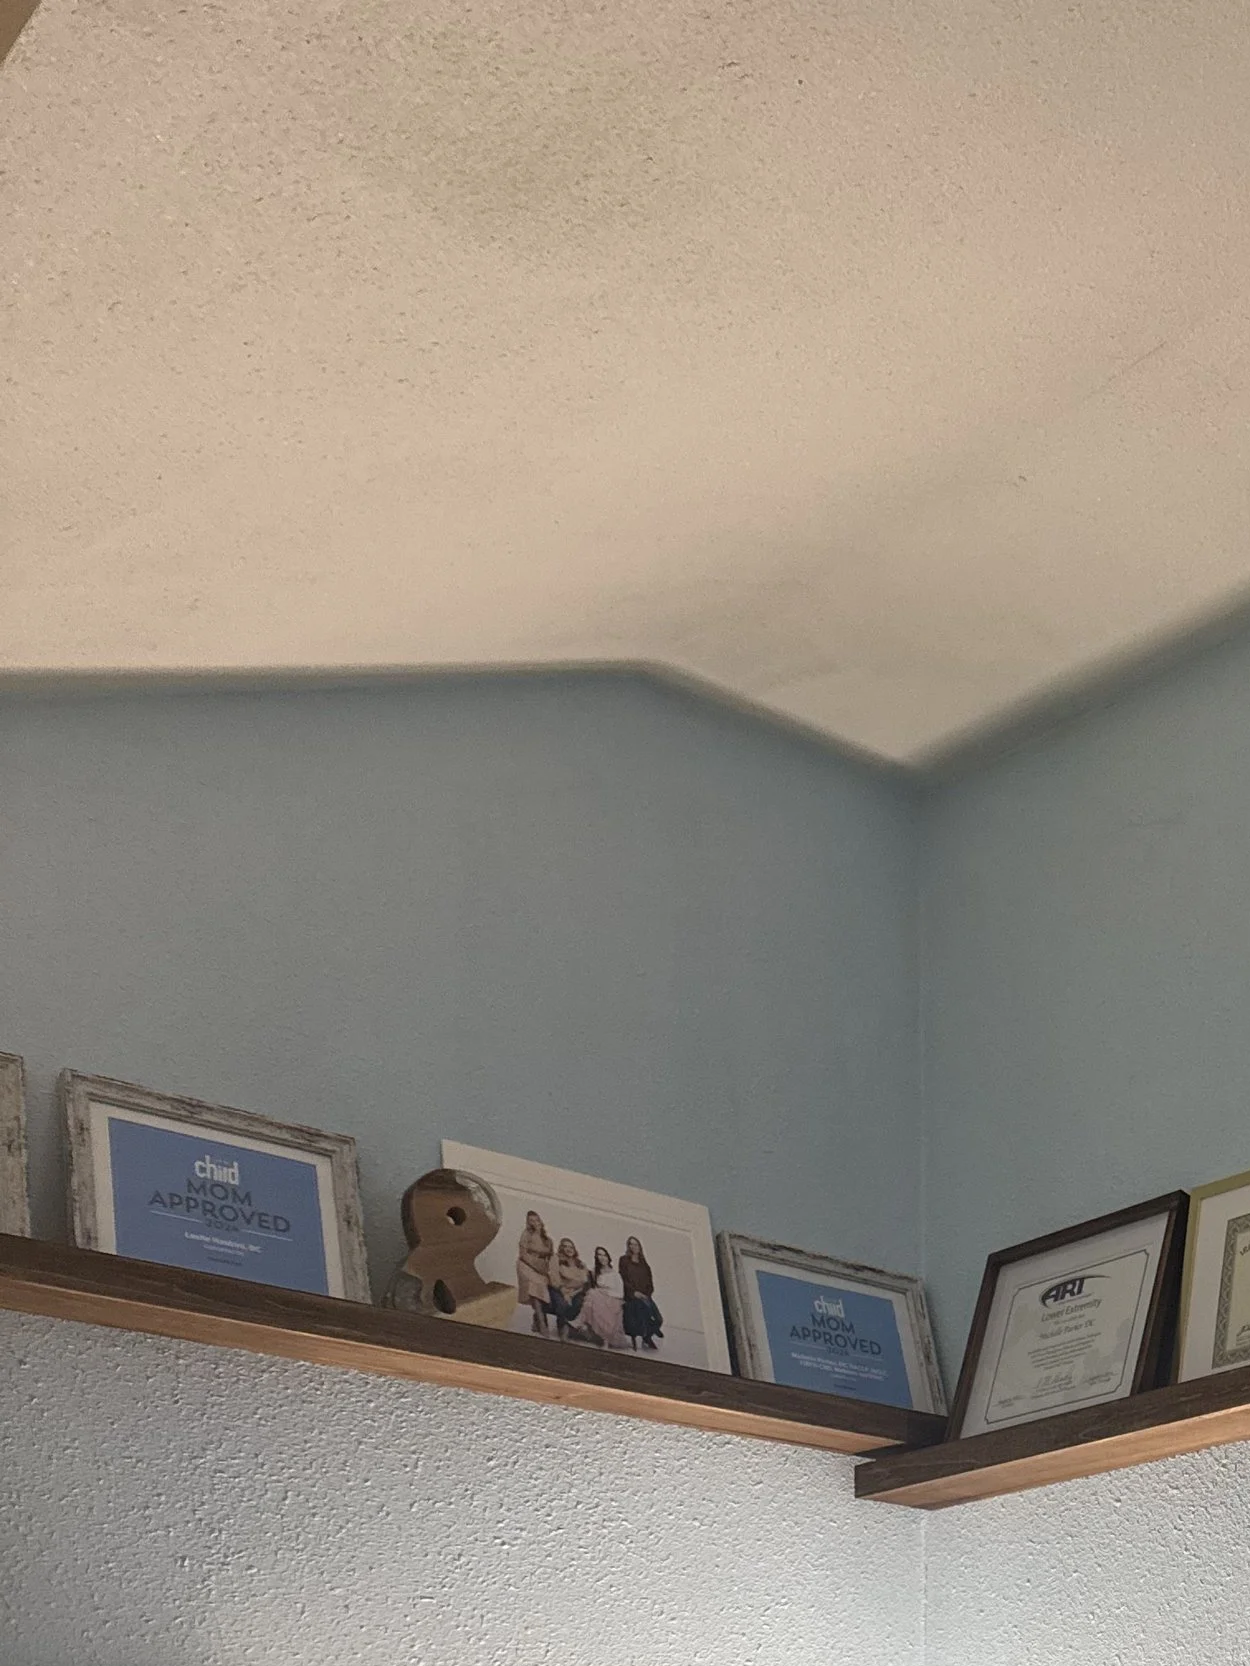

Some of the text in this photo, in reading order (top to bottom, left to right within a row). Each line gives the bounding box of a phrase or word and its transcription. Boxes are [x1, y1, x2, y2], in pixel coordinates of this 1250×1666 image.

[186, 1177, 252, 1207] MOM
[149, 1190, 292, 1234] APPROVED
[789, 1325, 882, 1356] APPROVED
[811, 1315, 856, 1336] MOM
